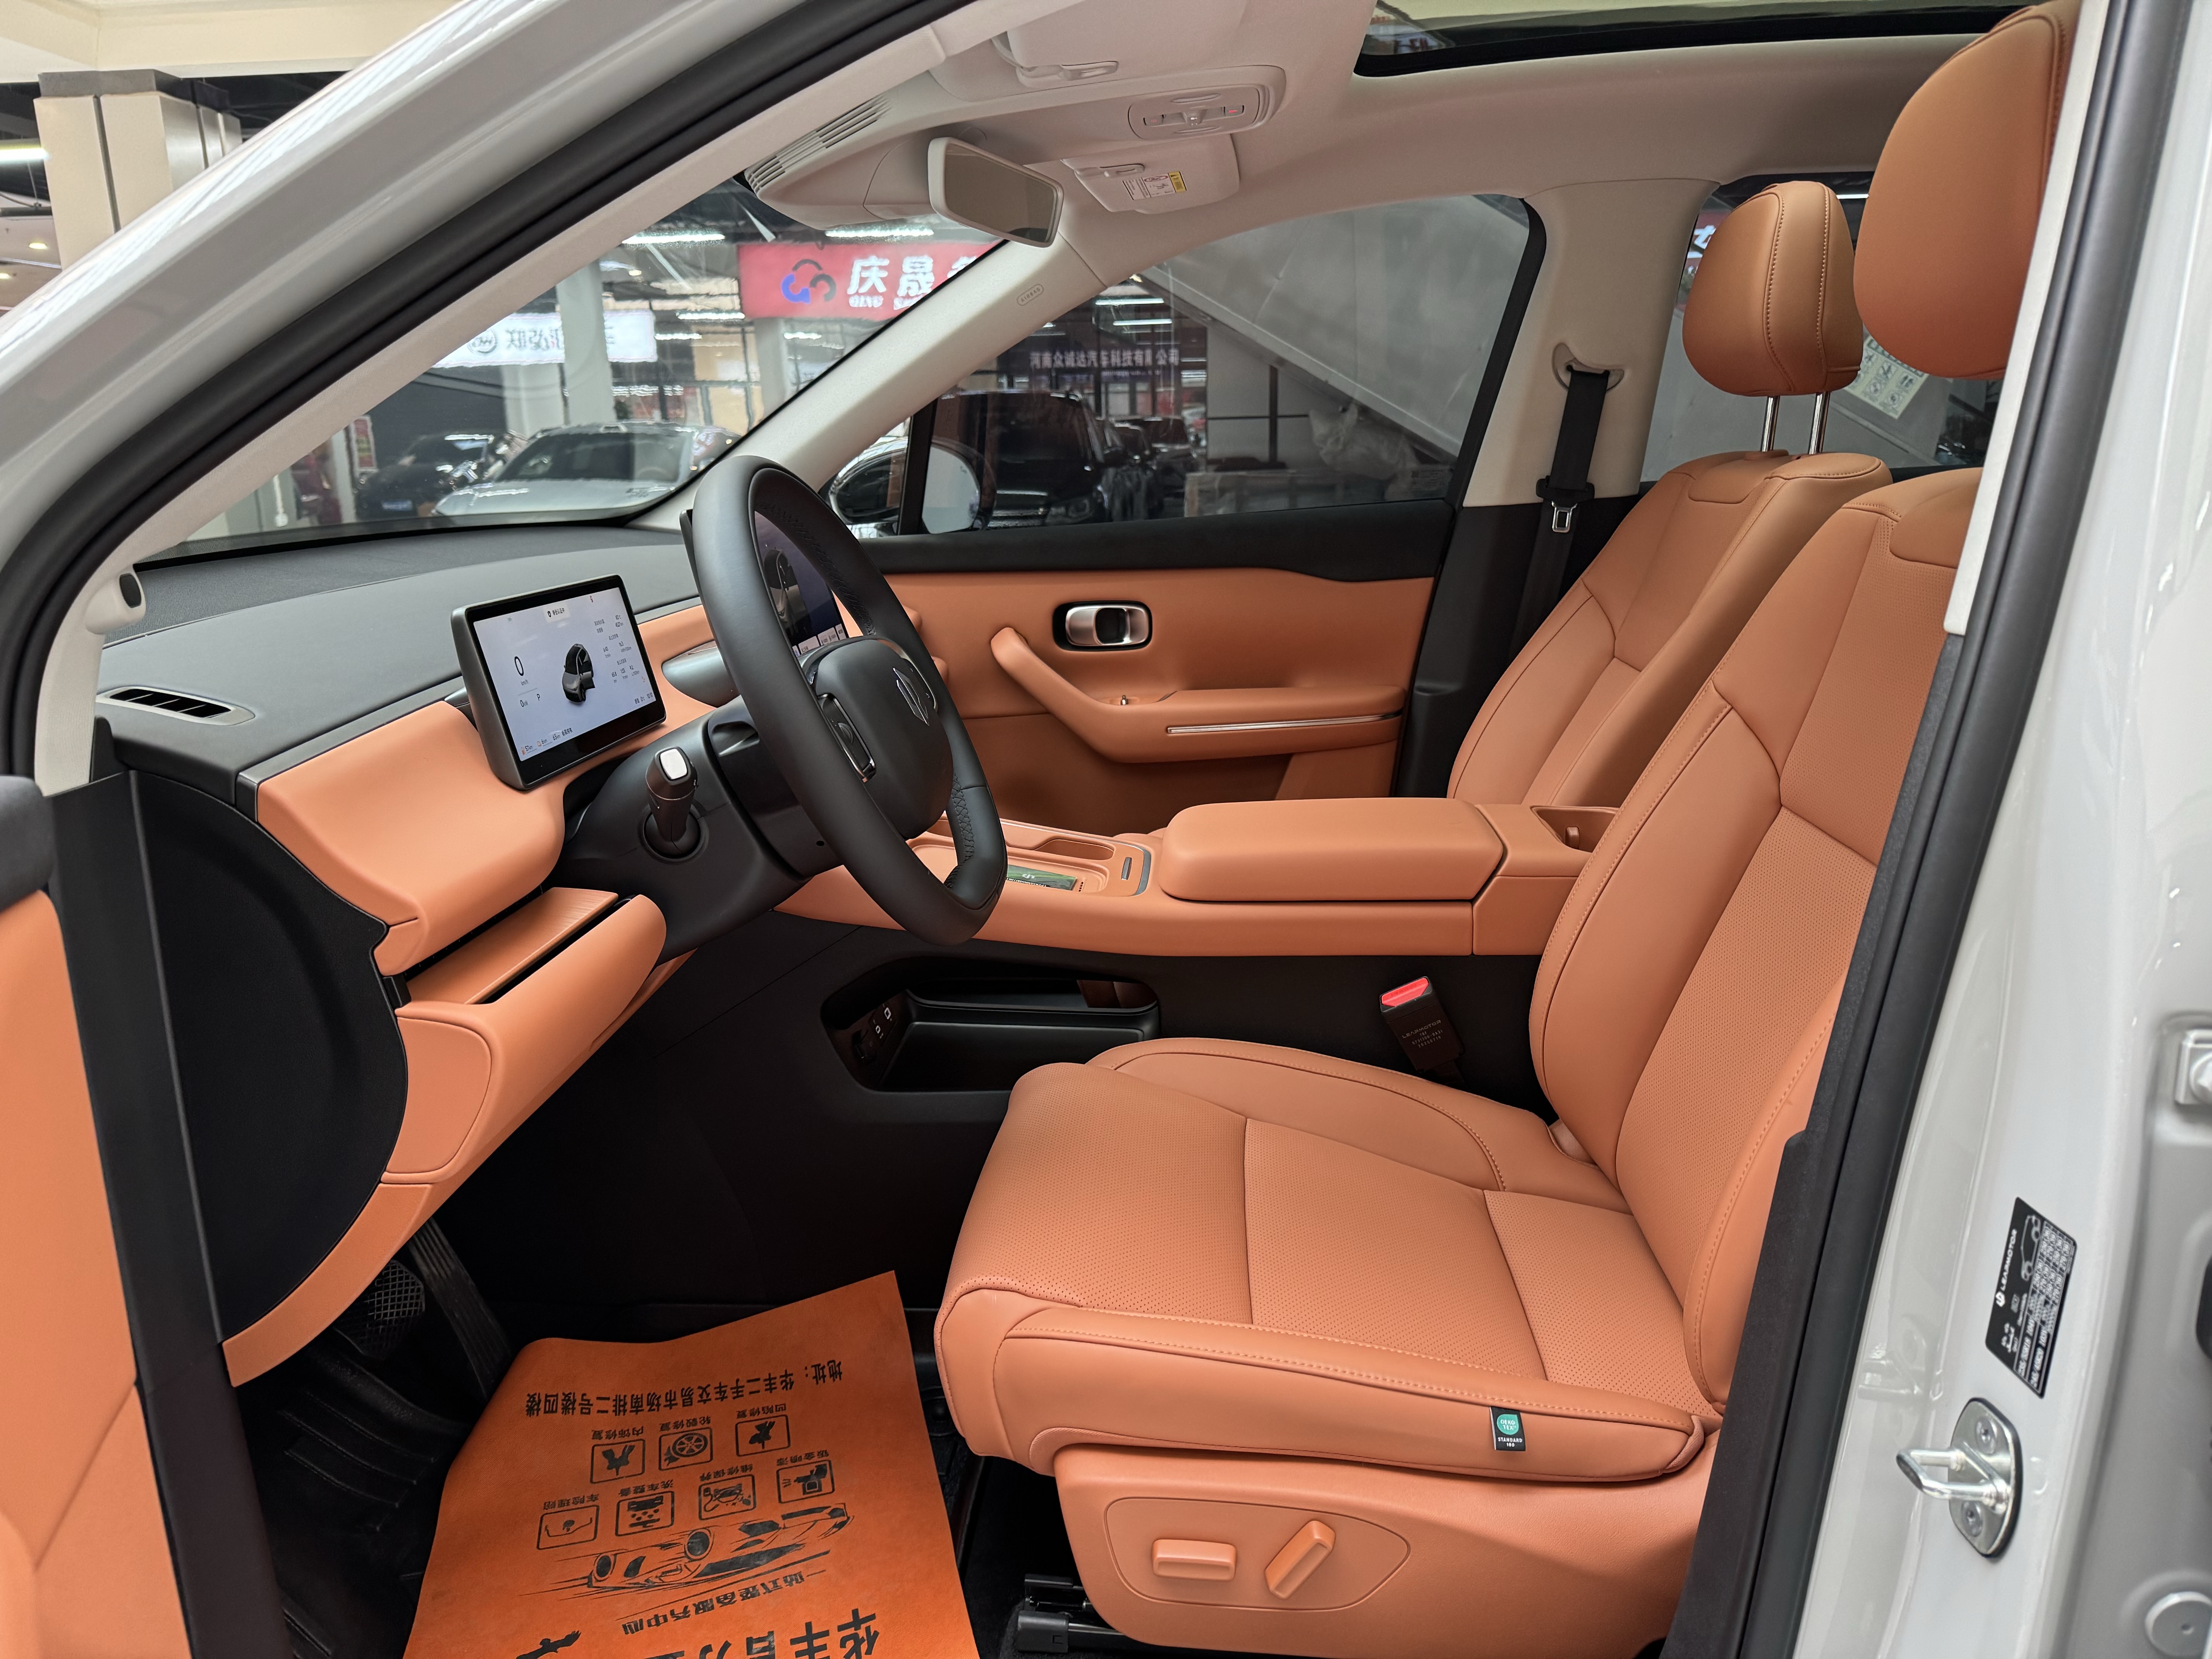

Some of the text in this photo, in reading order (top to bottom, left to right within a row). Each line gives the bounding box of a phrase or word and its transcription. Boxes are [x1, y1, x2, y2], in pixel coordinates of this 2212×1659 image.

[1020, 286, 1041, 304] AIRBAG
[2001, 1229, 2017, 1291] LEAPMOTOR
[736, 1404, 787, 1419] 凹陷修复
[592, 1425, 645, 1440] 内饰修复
[659, 1416, 711, 1432] 轮毂修复
[776, 1449, 830, 1467] 钣金喷漆
[699, 1464, 753, 1482] 维修保养
[619, 1479, 674, 1497] 洗车整备
[542, 1493, 599, 1511] 车险理赔
[622, 1570, 825, 1635] 一站式整备服务中心
